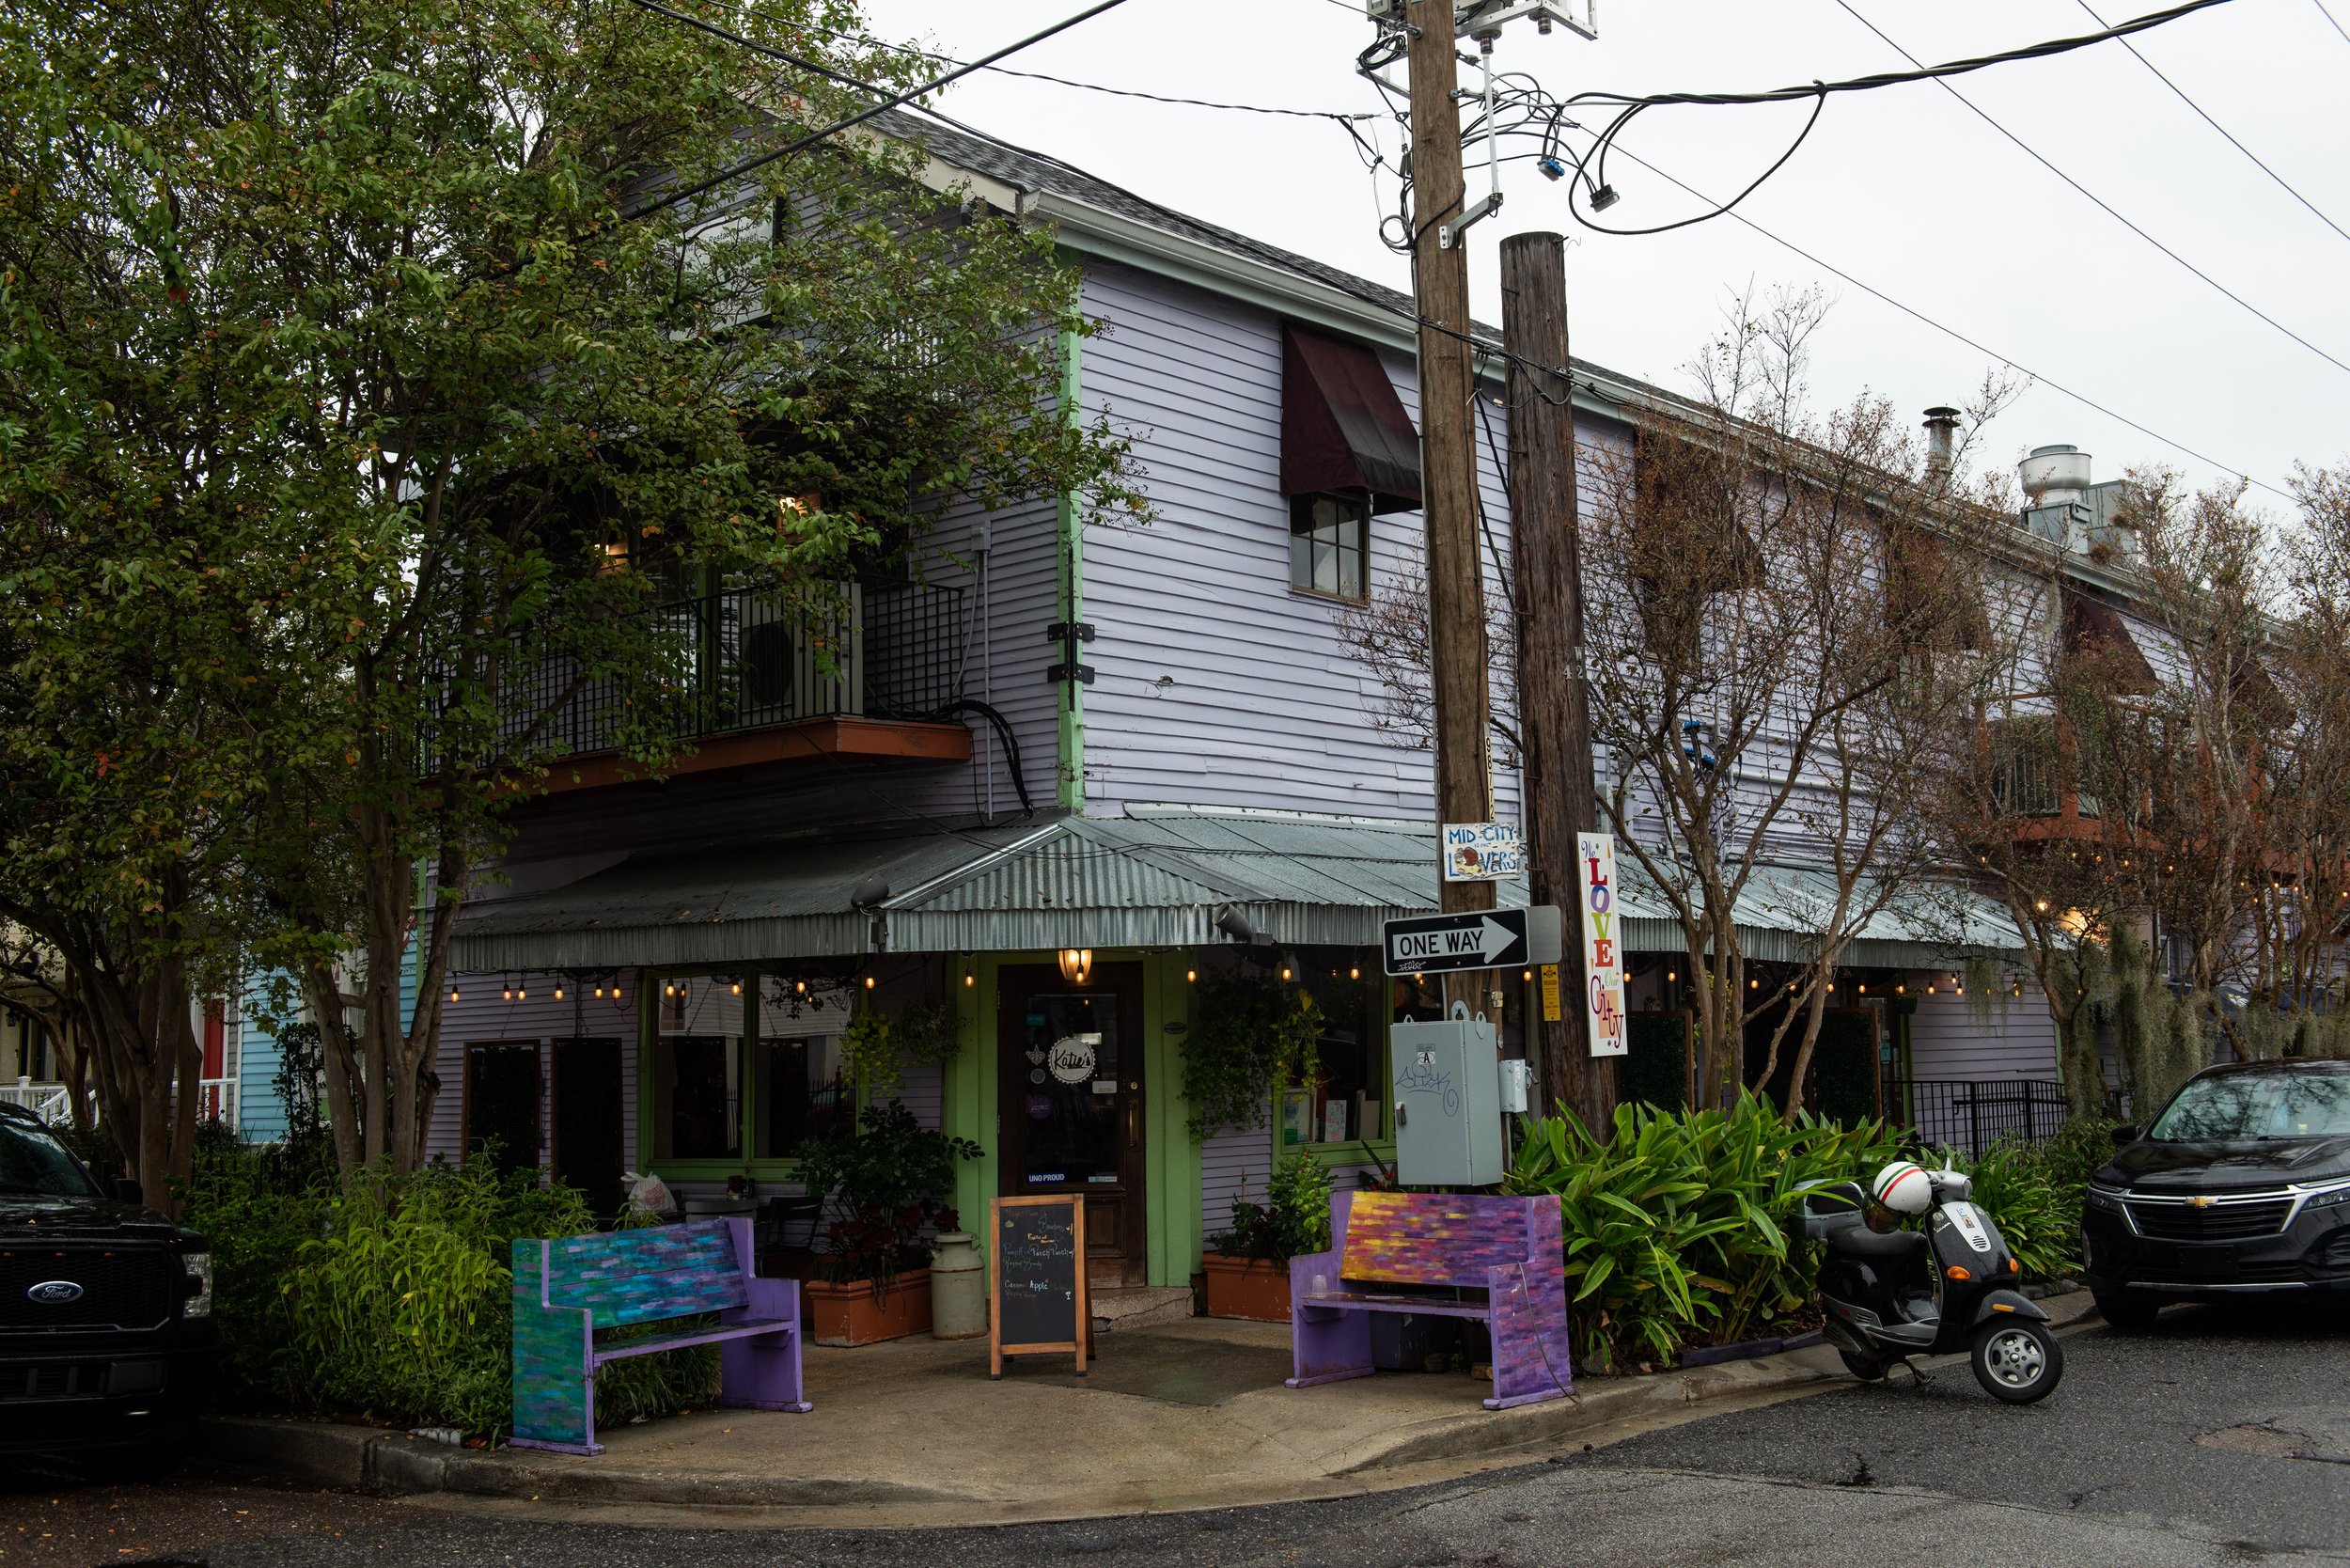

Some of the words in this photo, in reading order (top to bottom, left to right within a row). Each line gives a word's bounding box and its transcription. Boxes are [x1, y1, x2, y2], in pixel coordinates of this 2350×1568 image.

[1449, 825, 1515, 844] MID-CITY
[1581, 840, 1596, 858] We
[1449, 851, 1516, 876] LVERS
[1589, 858, 1614, 967] LOVE
[1400, 933, 1440, 956] ONE
[1445, 929, 1484, 952] WAY
[1605, 969, 1620, 987] Our
[1590, 975, 1624, 1049] City
[1054, 1047, 1091, 1071] Katie's
[1042, 1173, 1065, 1182] PROUD
[41, 1285, 72, 1299] Ford
[1029, 1279, 1049, 1292] Apple
